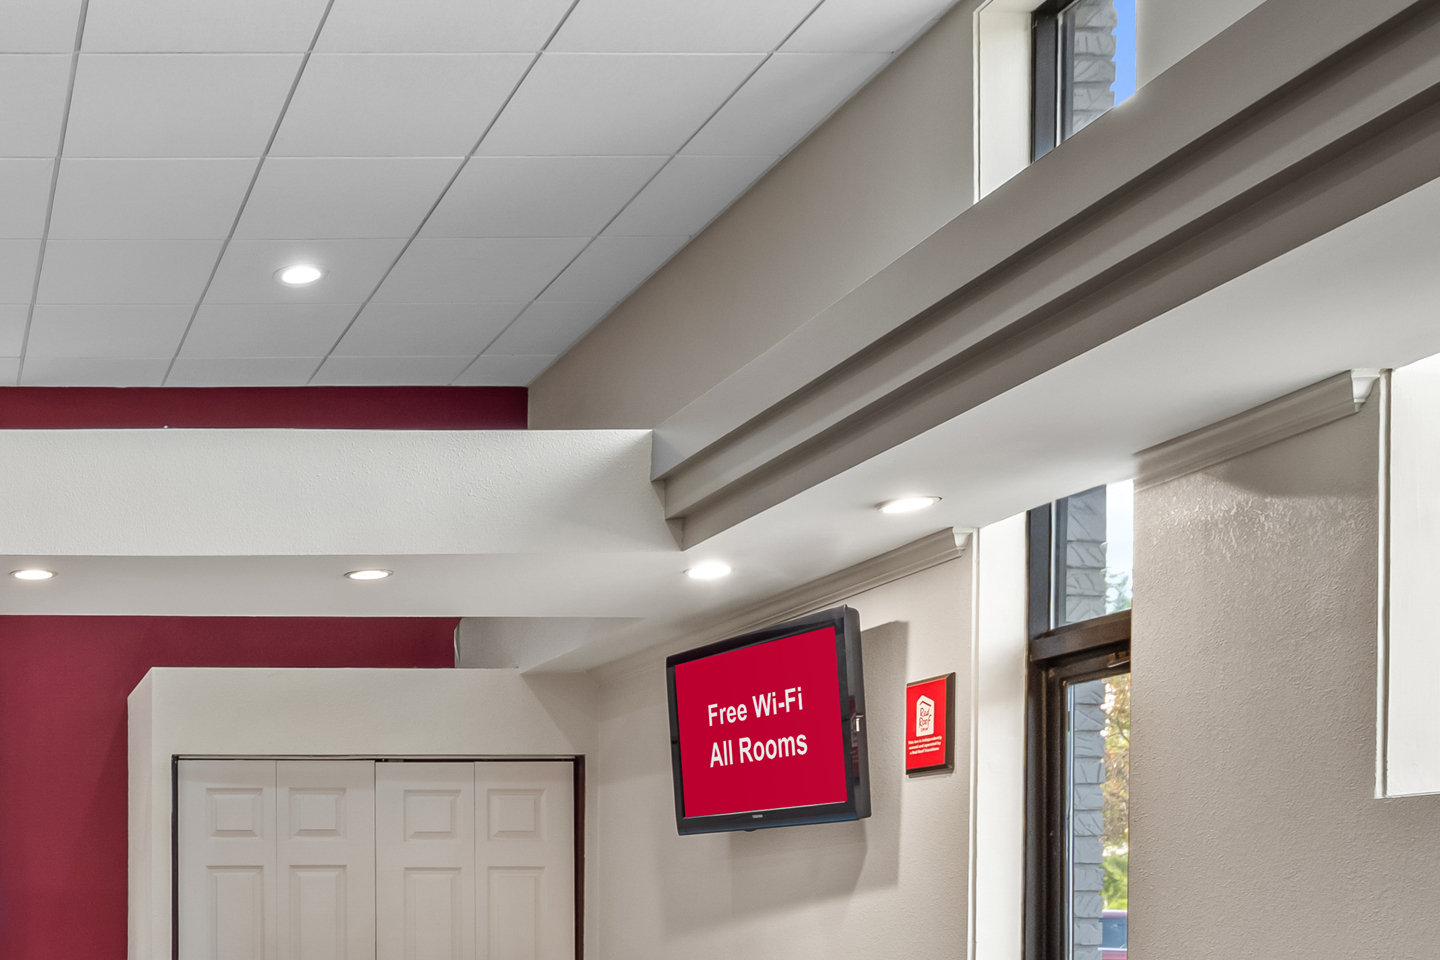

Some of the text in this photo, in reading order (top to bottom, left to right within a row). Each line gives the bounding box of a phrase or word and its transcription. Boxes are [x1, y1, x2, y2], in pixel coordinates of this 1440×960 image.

[707, 686, 803, 727] Free Wi-Fi
[709, 734, 808, 768] All Rooms
